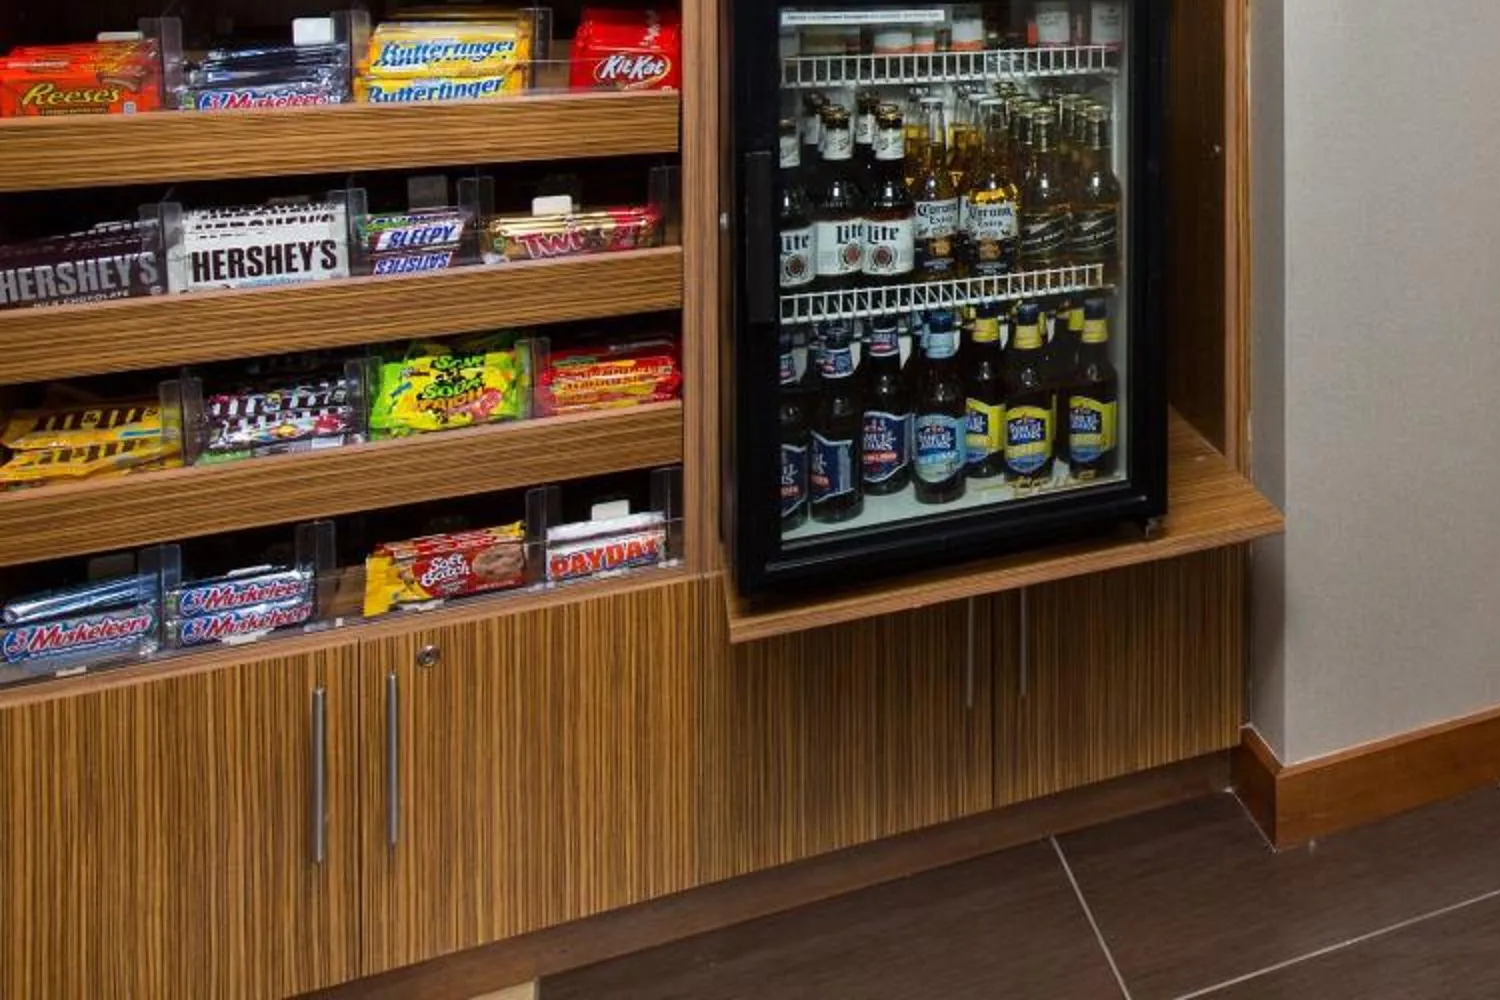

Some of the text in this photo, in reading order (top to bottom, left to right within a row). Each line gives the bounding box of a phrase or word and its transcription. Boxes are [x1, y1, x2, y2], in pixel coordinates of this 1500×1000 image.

[389, 225, 458, 249] SLEEPY
[0, 251, 159, 305] HERSHEY'S
[191, 239, 338, 283] HERSHEY'S
[30, 616, 151, 651] Musketeers
